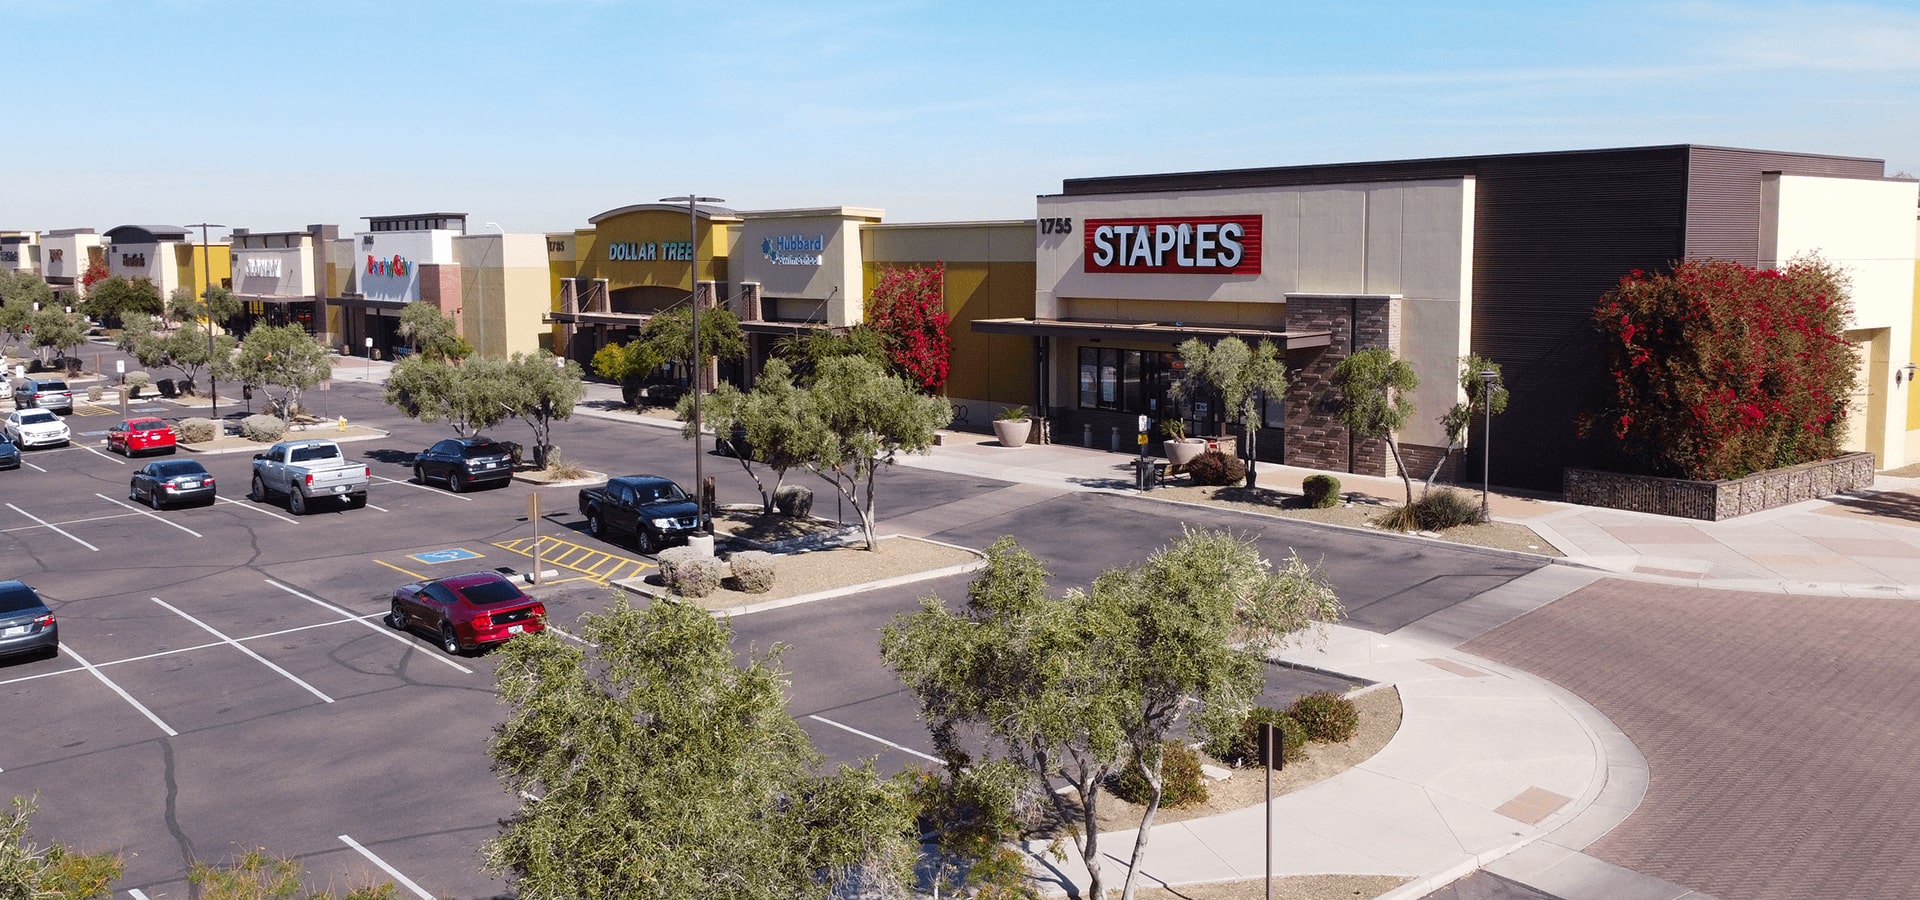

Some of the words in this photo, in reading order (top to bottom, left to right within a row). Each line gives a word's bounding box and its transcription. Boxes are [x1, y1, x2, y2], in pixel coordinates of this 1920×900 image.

[1040, 218, 1072, 234] 1755
[609, 242, 656, 261] DOLLAR
[662, 242, 692, 261] TREE
[777, 234, 823, 251] Hubbard
[1093, 223, 1243, 267] STAPLES
